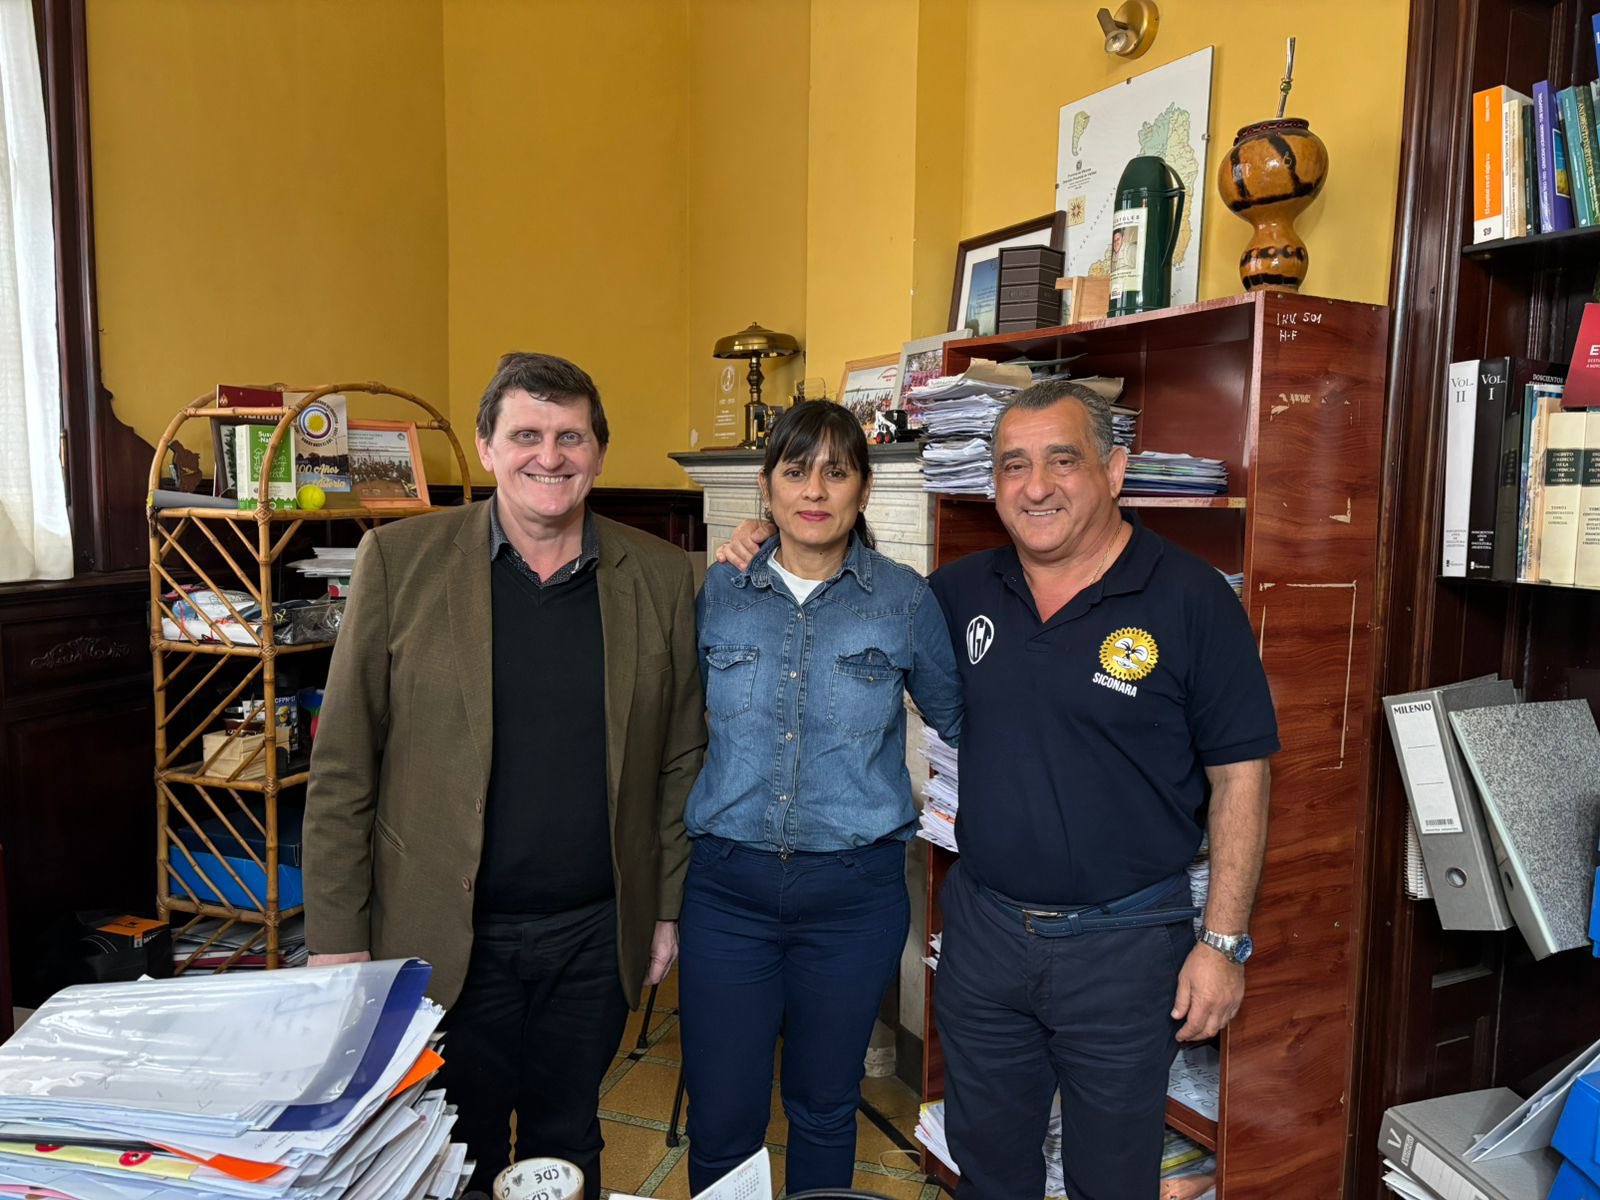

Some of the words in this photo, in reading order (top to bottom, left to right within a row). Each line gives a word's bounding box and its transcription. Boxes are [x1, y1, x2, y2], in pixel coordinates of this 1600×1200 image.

[1456, 391, 1466, 403] II
[1488, 387, 1495, 401] I
[1092, 672, 1138, 698] SICONARA
[1393, 703, 1432, 714] MILENIO
[534, 1168, 559, 1184] CDE
